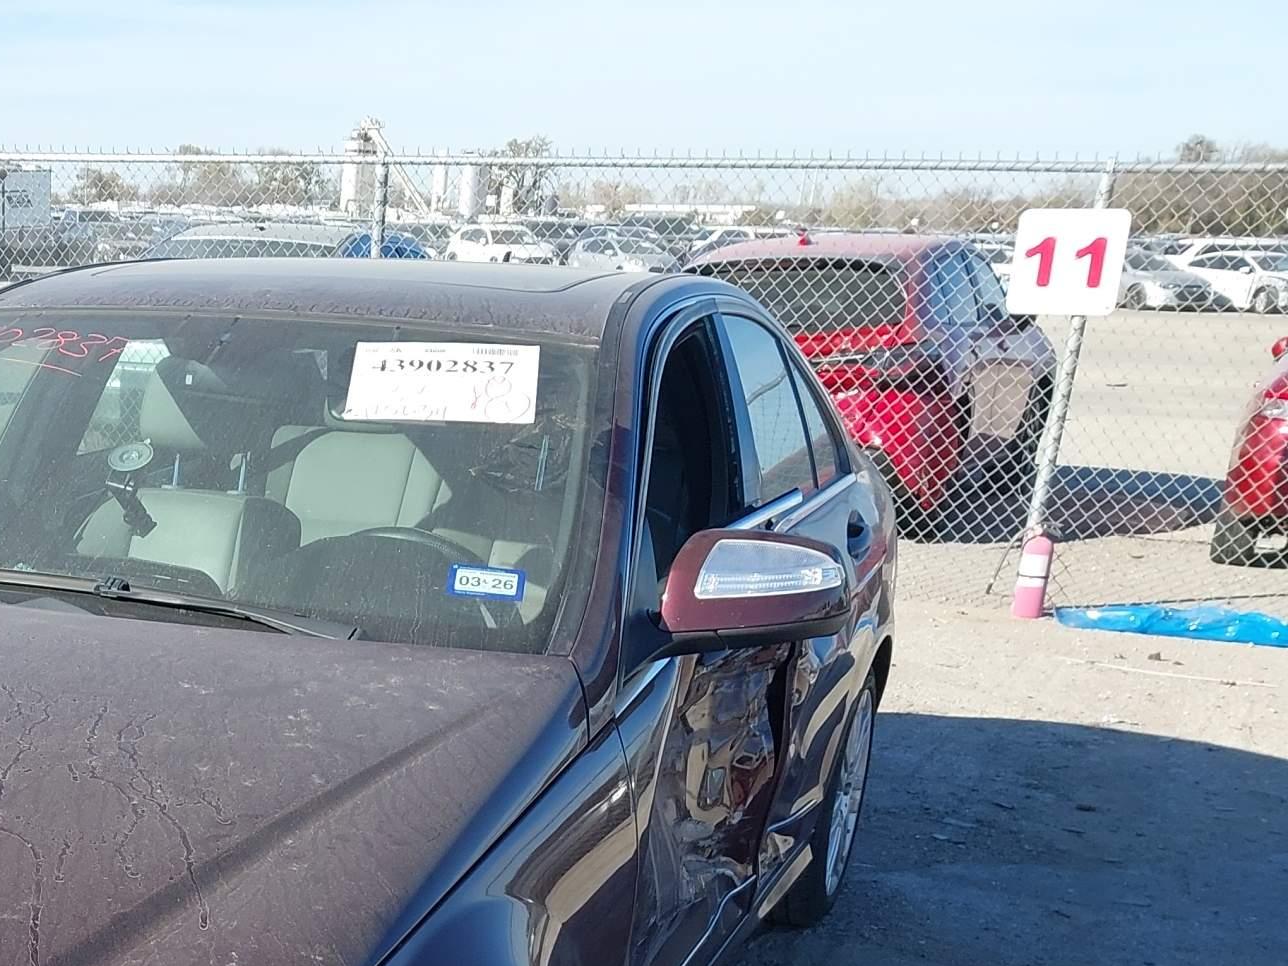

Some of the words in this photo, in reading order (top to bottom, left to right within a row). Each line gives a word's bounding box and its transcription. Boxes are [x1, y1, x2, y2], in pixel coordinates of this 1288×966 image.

[1025, 236, 1108, 289] 11
[371, 358, 515, 374] 43902837
[459, 575, 481, 587] 03
[491, 578, 514, 590] 26
